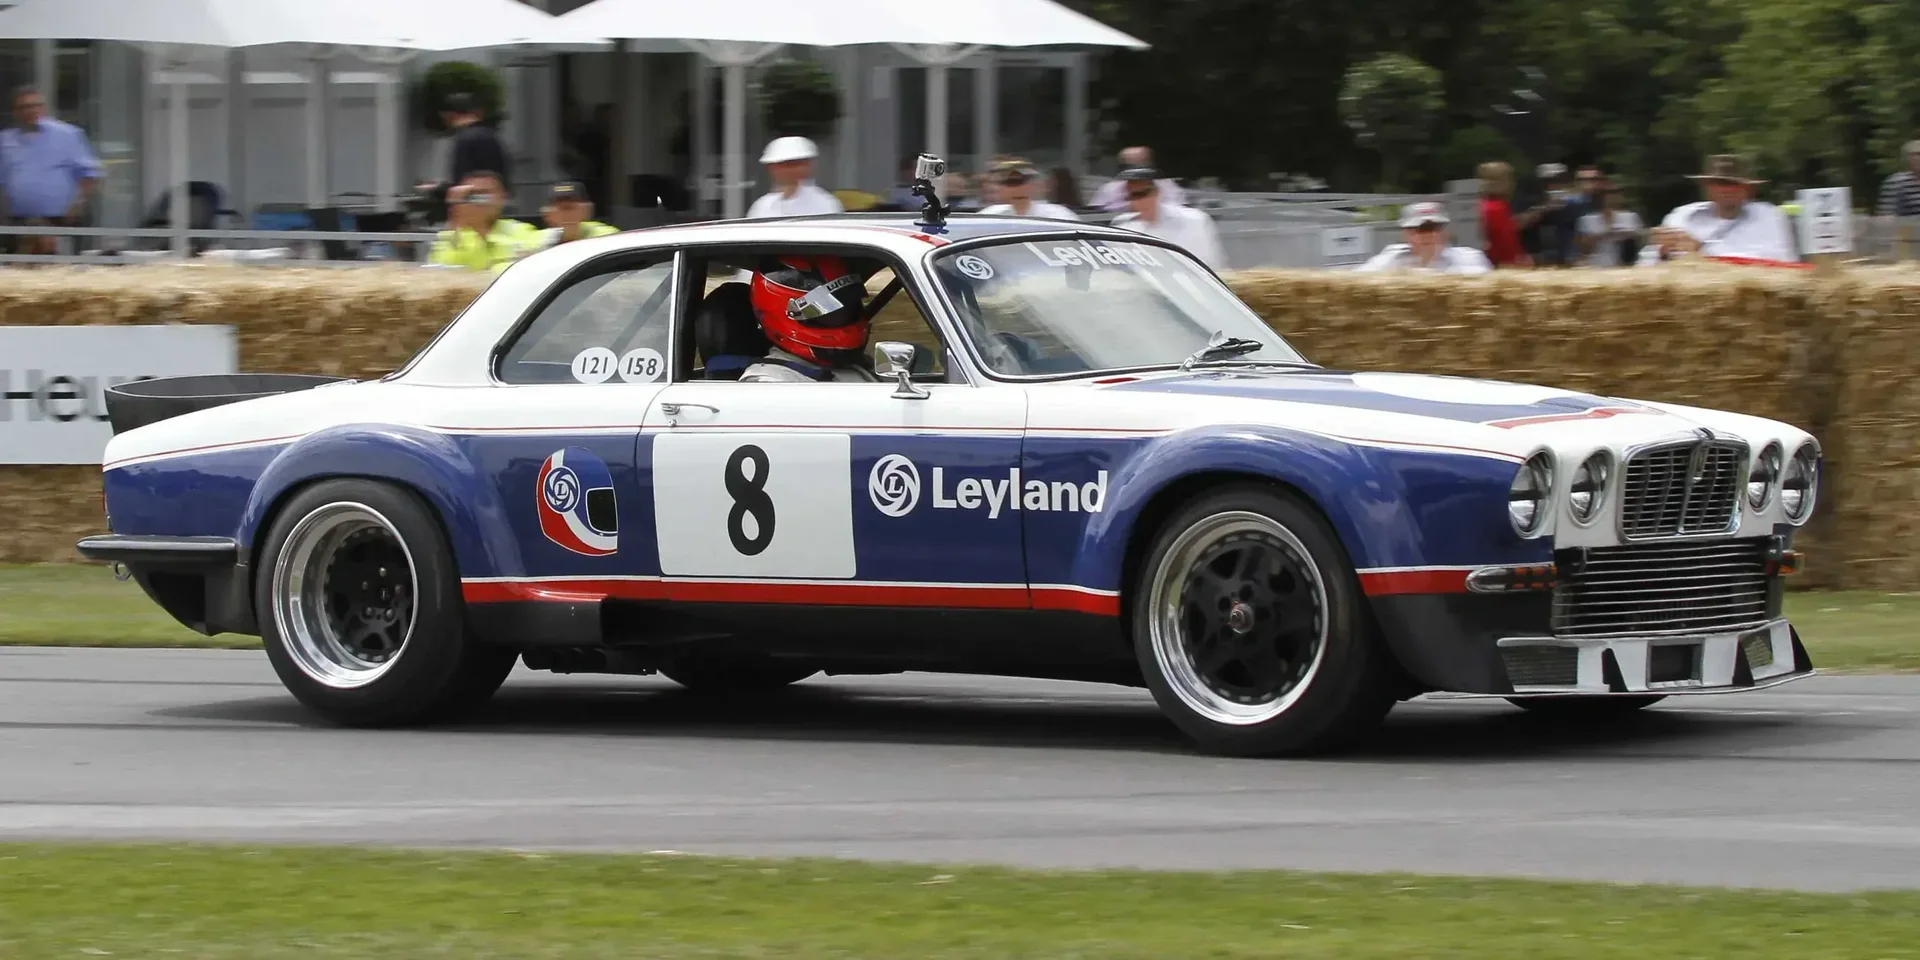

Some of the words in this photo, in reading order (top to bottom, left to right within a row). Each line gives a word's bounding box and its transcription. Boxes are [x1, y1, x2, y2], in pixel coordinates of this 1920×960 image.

[1022, 239, 1164, 270] Leyland
[582, 357, 608, 374] 121
[627, 357, 658, 376] 158
[724, 444, 776, 556] 8
[887, 476, 904, 494] L
[932, 467, 1108, 519] Leyland
